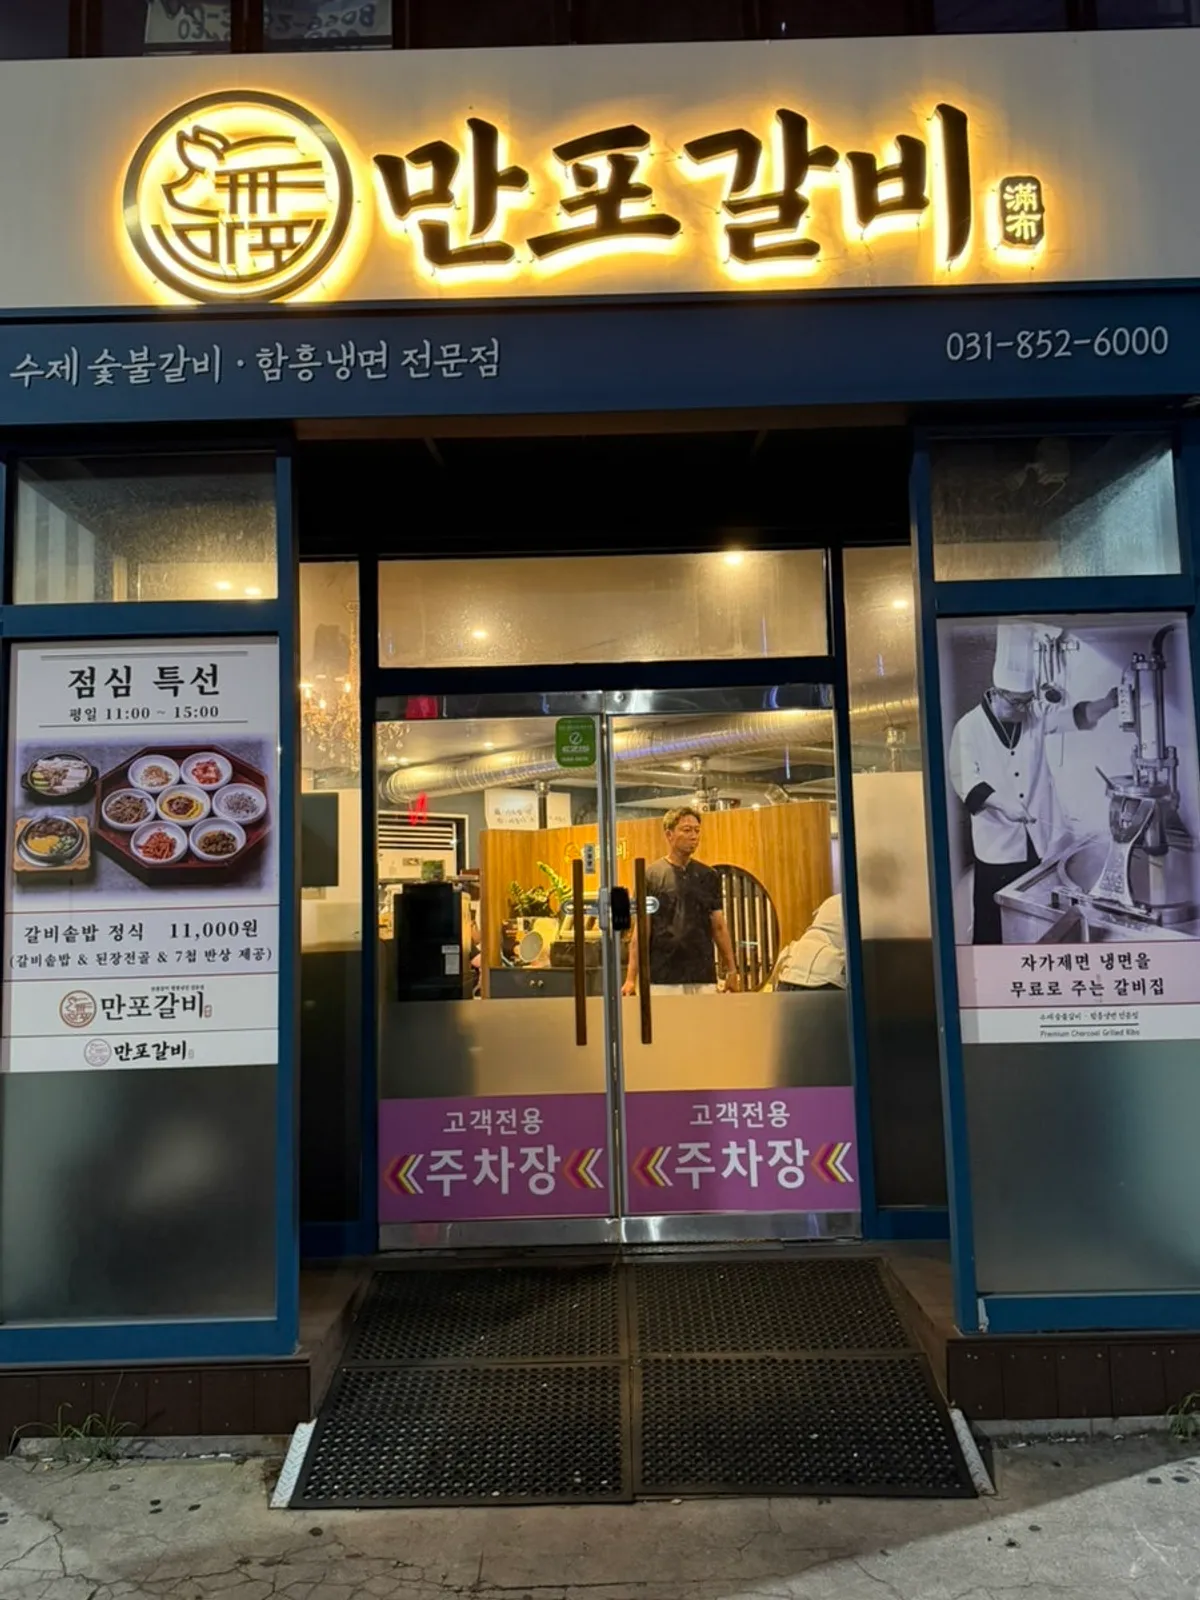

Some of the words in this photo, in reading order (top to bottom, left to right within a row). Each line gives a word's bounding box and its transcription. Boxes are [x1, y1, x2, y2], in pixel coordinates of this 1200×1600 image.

[372, 103, 971, 268] 만포갈비
[946, 326, 1169, 361] 031-852-6000
[9, 346, 79, 388] 수제
[88, 344, 222, 385] 숯불갈비
[256, 340, 388, 383] 함흥냉면
[401, 337, 500, 379] 전문점
[68, 665, 133, 699] 점심
[152, 663, 220, 698] 특선
[69, 707, 97, 722] 평일
[106, 707, 150, 720] 11:00
[174, 706, 219, 719] 15:00
[24, 924, 100, 944] 갈비솥밥
[108, 922, 144, 942] 정식
[169, 918, 259, 940] 11,000원
[77, 953, 89, 966] &
[96, 950, 151, 967] 된장전골
[157, 952, 168, 963] &
[204, 949, 232, 963] 반상
[238, 947, 272, 962] 제공)
[1100, 952, 1151, 971] 냉면을
[1010, 981, 1063, 998] 무료로
[1072, 980, 1105, 997] 주는
[1114, 978, 1164, 996] 갈비집
[101, 991, 204, 1021] 만포갈비
[114, 1040, 187, 1062] 만포갈비
[443, 1107, 544, 1136] 고객전용
[690, 1101, 791, 1129] 고객전용
[426, 1144, 561, 1197] 주차장
[675, 1138, 810, 1190] 주차장
